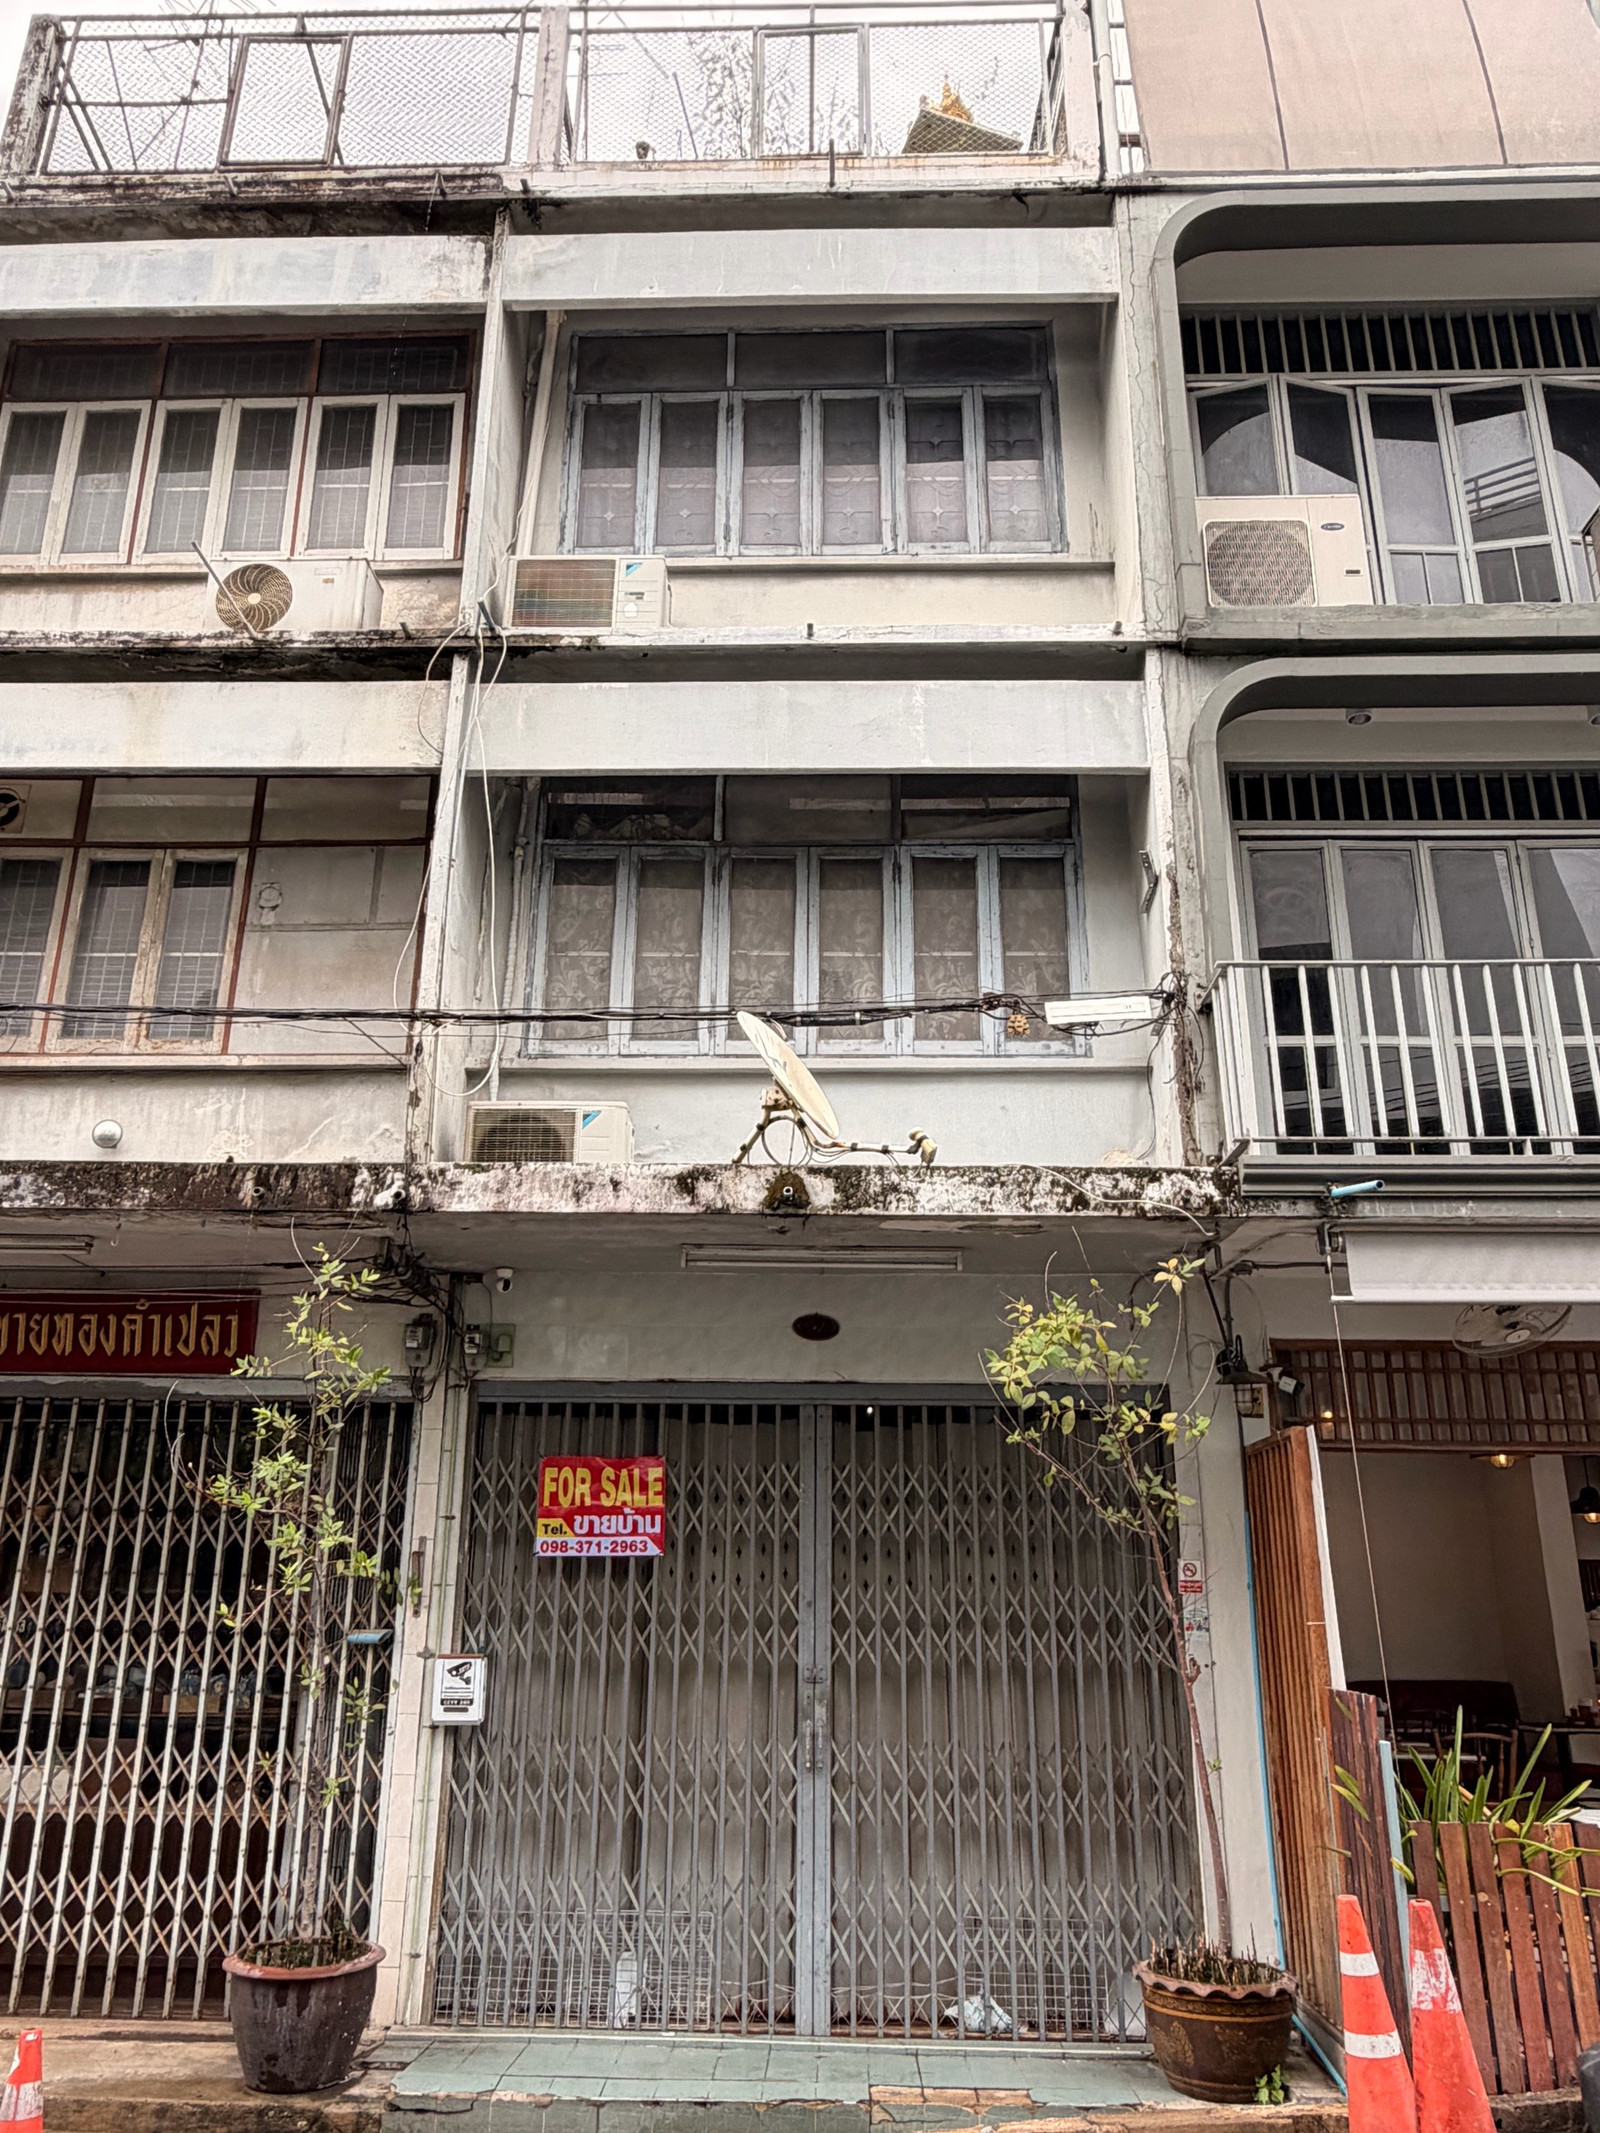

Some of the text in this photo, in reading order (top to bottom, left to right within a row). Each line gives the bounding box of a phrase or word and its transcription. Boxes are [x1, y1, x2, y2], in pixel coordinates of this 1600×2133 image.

[543, 1466, 663, 1507] FOR SALE
[542, 1523, 567, 1535] Tel.
[573, 1507, 661, 1534] ขายบ้าน
[540, 1540, 648, 1554] 098-371-2963
